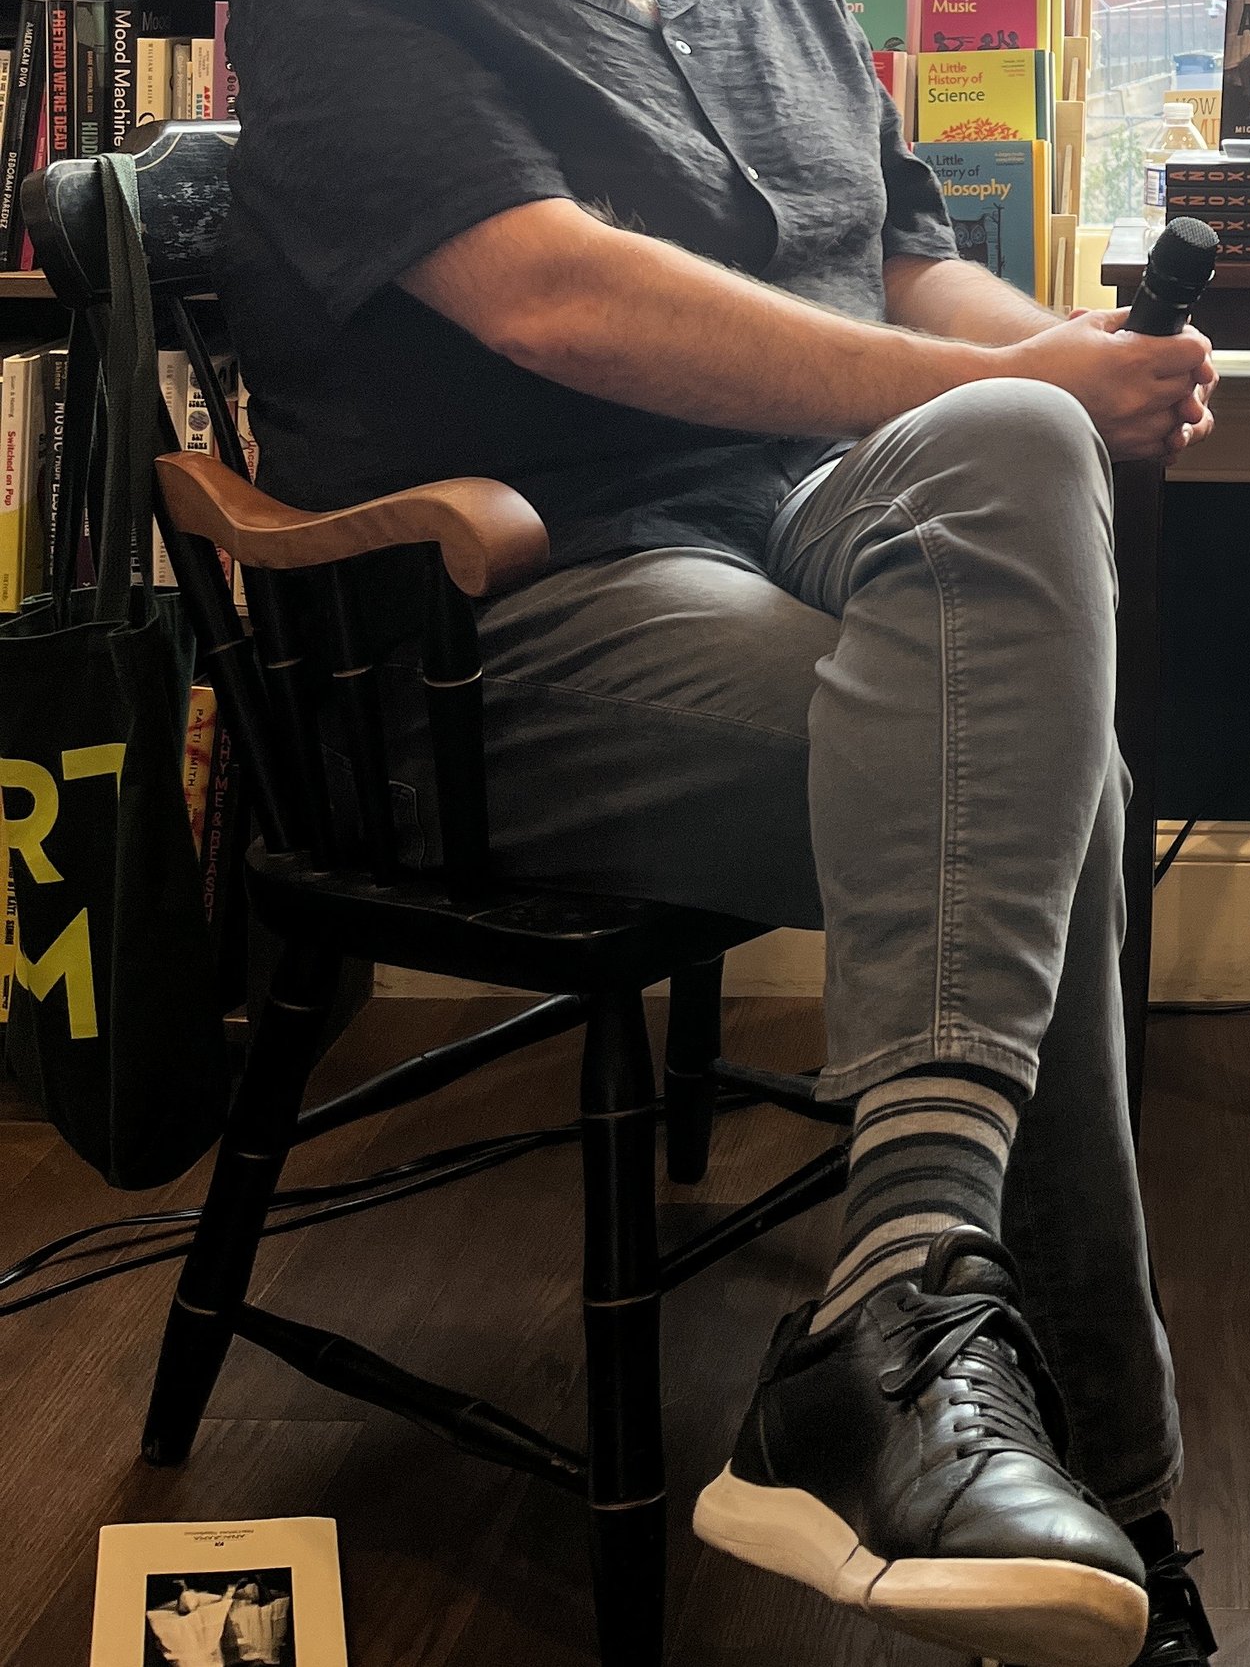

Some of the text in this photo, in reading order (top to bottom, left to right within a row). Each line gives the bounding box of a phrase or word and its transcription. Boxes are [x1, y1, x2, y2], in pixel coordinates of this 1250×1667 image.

[932, 0, 977, 13] Music
[929, 62, 967, 74] A Little
[52, 9, 68, 151] PRETEND WE'RE DEAD
[113, 9, 131, 147] Mood Machine
[928, 72, 983, 88] History of
[928, 88, 985, 103] Science
[943, 178, 1012, 201] ilosophy
